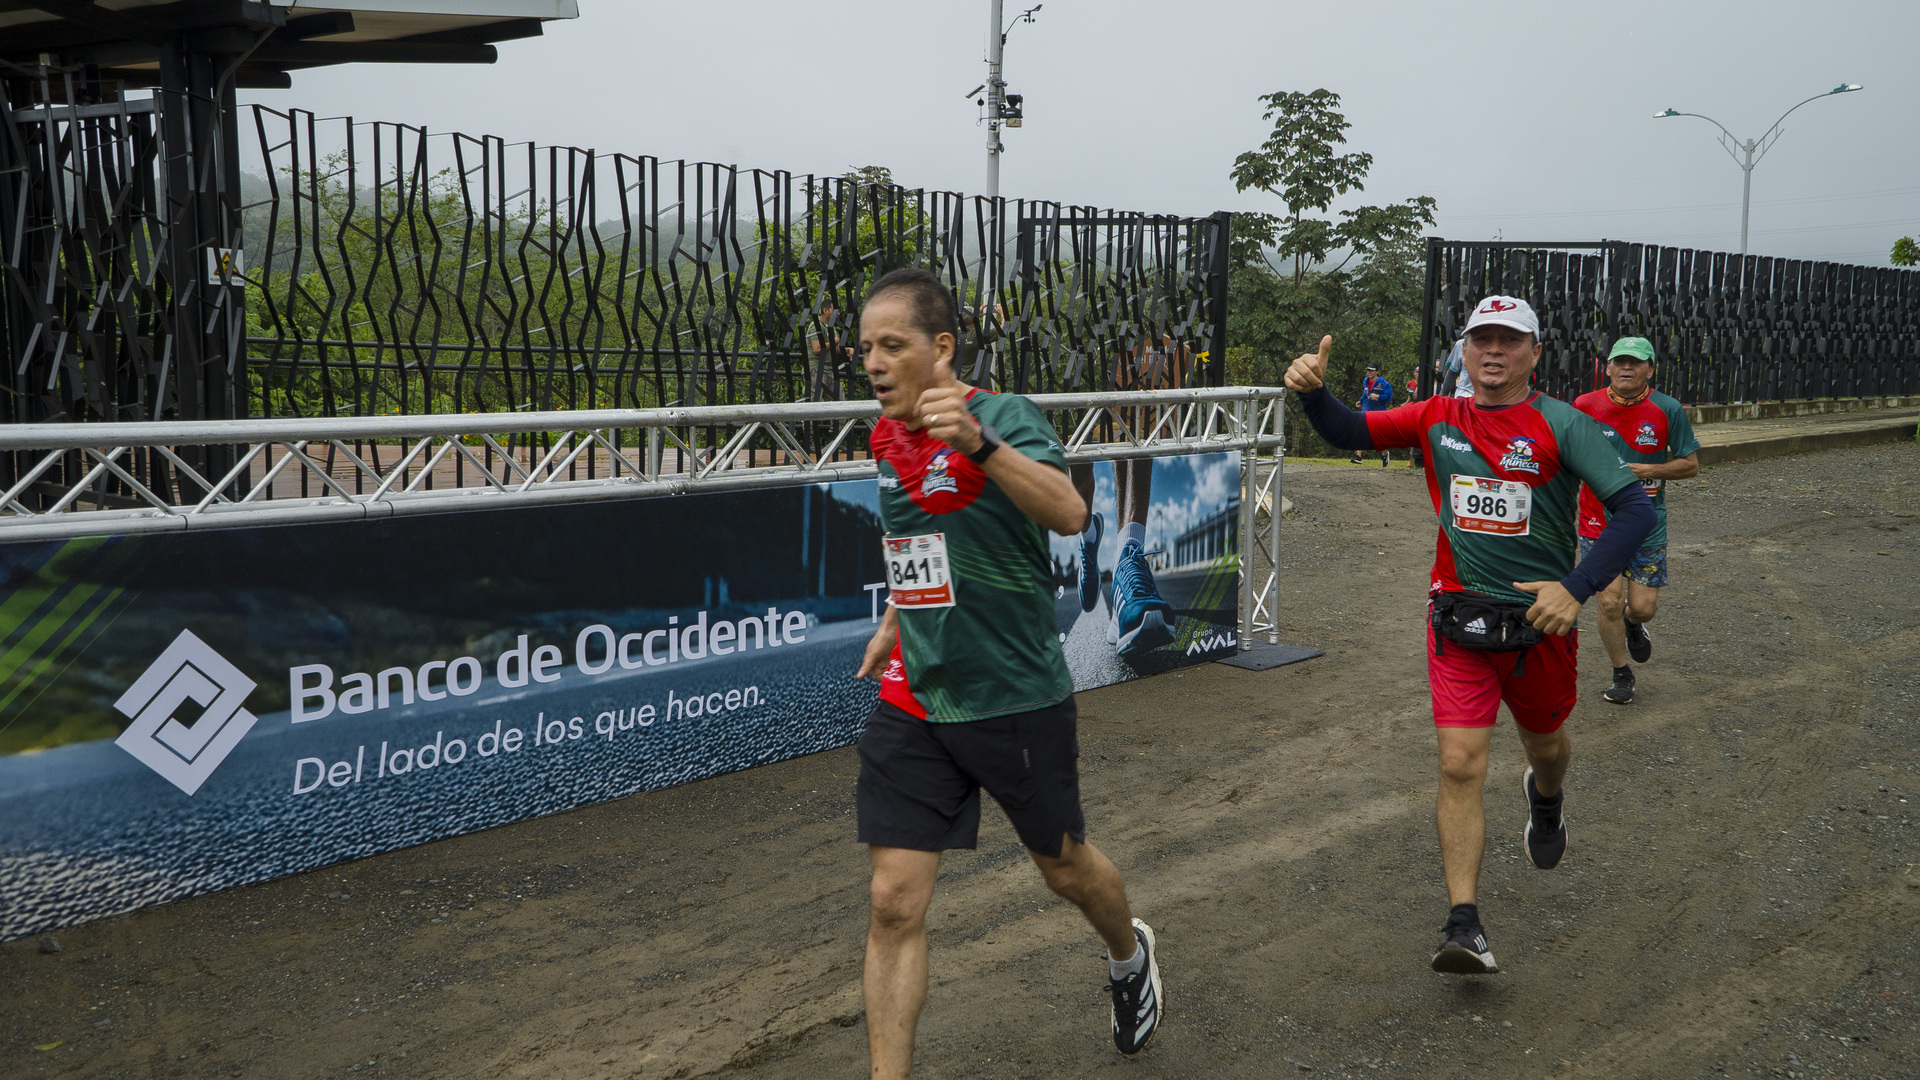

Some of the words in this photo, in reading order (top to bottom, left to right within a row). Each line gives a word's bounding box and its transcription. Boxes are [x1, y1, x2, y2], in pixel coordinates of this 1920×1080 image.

[1499, 456, 1540, 470] Muñeca
[1467, 494, 1507, 518] 986
[892, 558, 931, 585] 841
[1186, 631, 1237, 657] AVAL
[1193, 628, 1213, 639] Grupo
[290, 657, 482, 724] Banco
[498, 634, 563, 687] de
[576, 607, 807, 675] Occidente
[293, 744, 365, 795] Del
[378, 731, 467, 778] lado
[477, 719, 524, 757] de
[535, 712, 584, 747] los
[595, 704, 656, 742] que
[666, 685, 766, 722] hacen.
